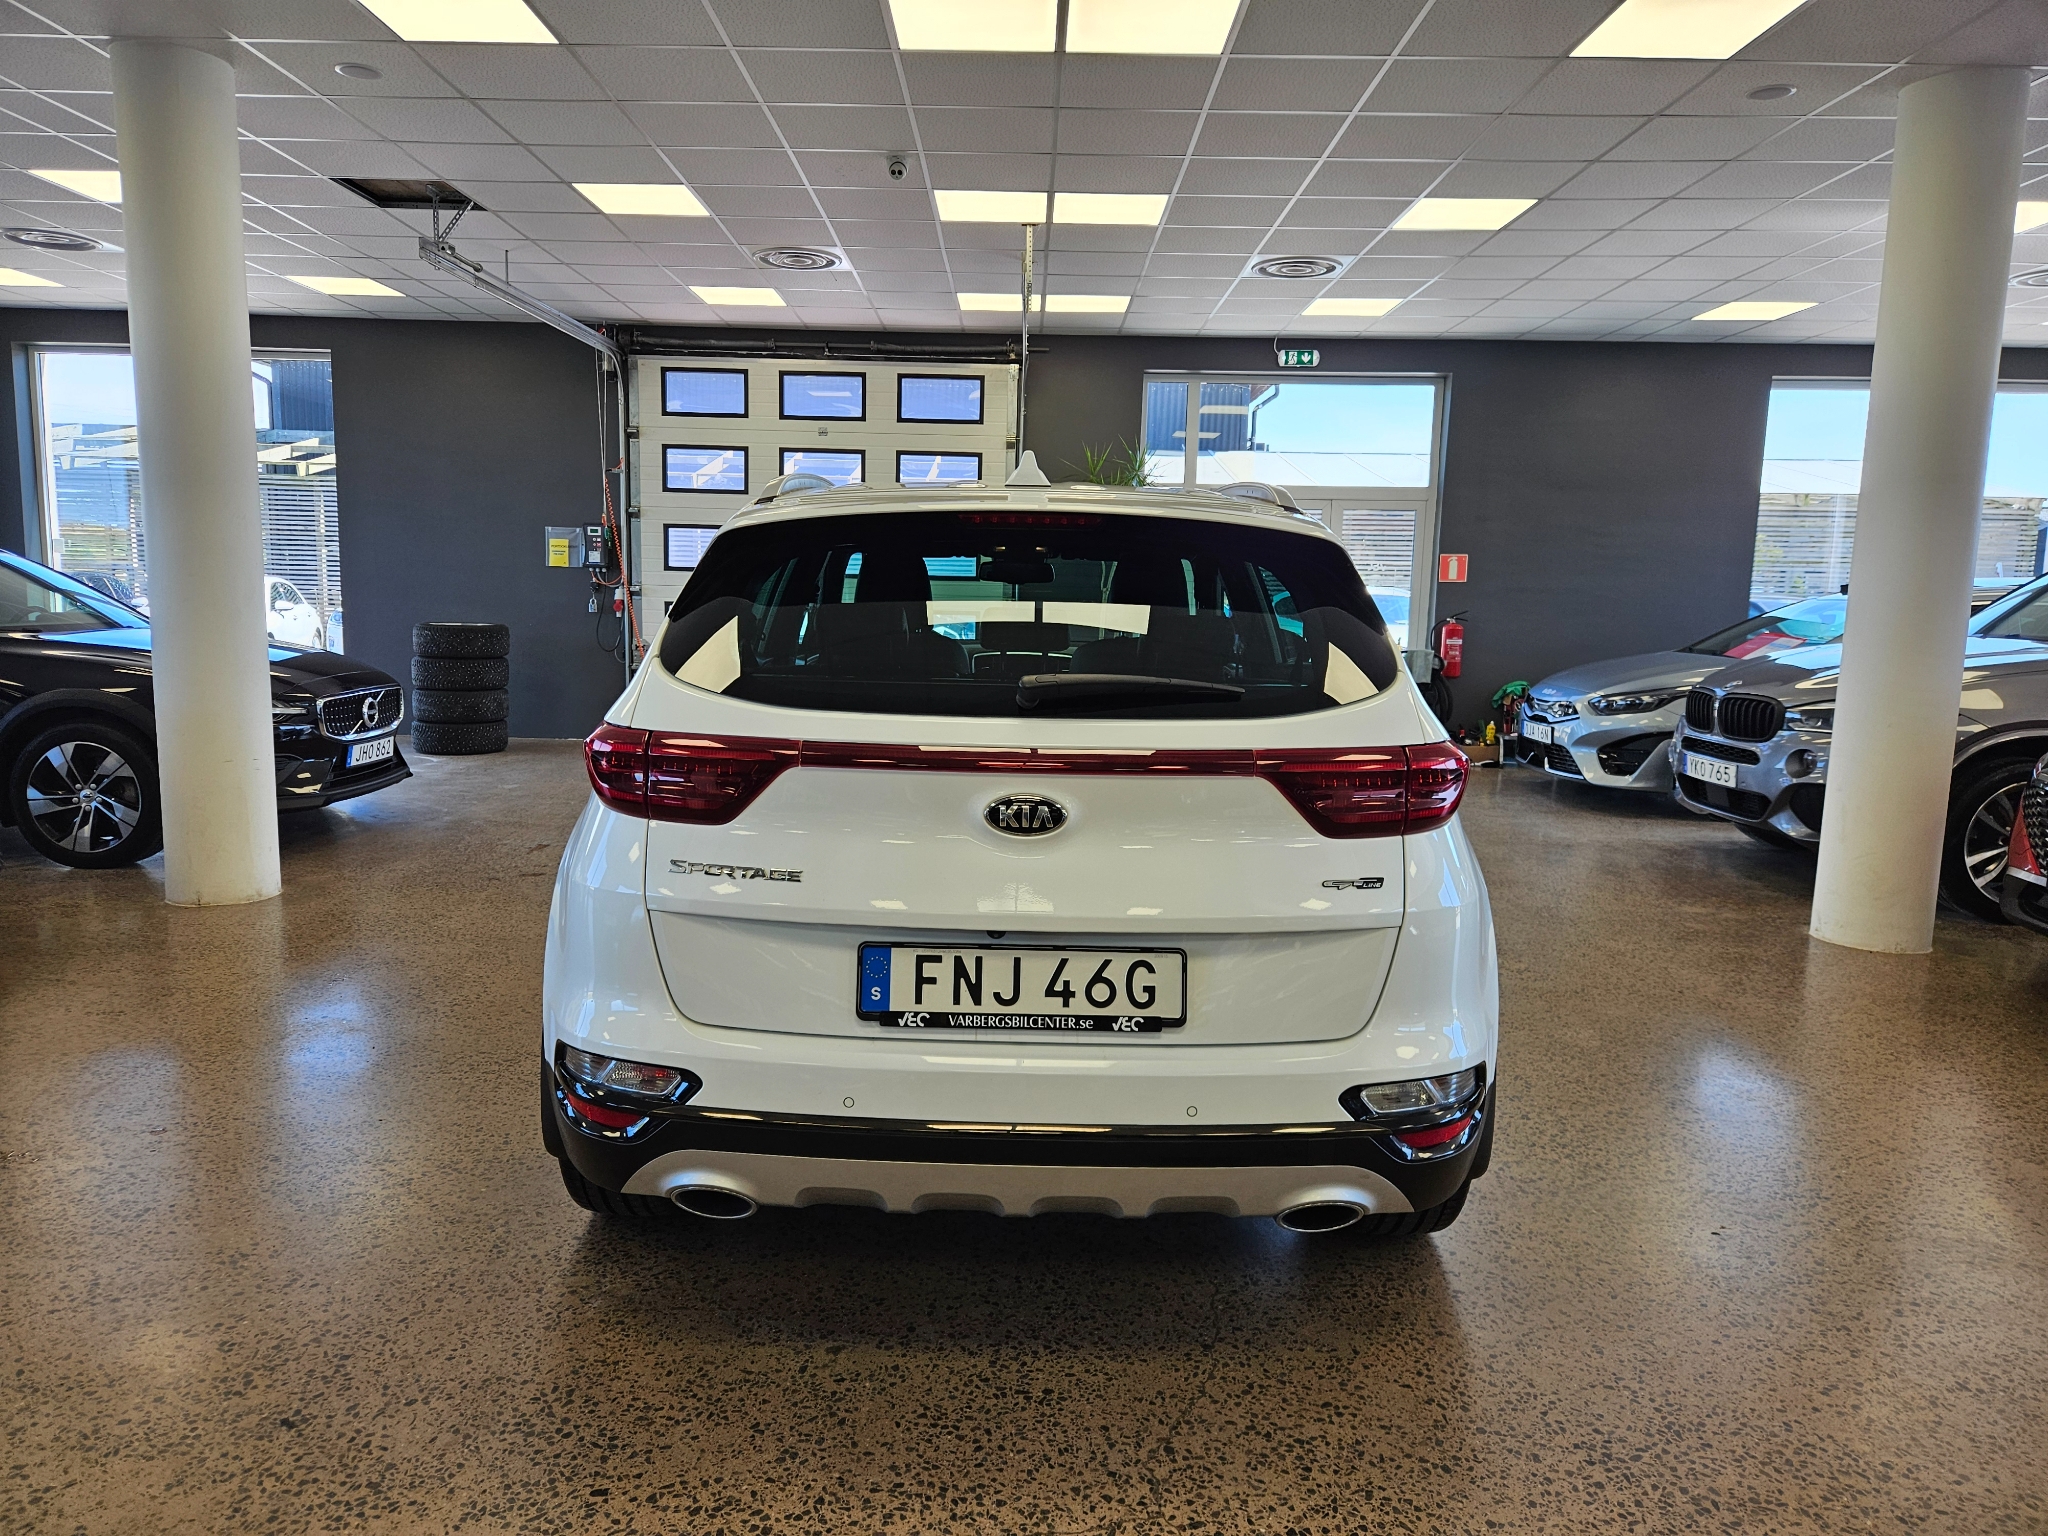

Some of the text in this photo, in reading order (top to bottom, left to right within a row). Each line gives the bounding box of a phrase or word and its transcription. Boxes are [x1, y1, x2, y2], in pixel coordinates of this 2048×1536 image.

[355, 739, 391, 762] JHO 862
[1708, 763, 1731, 783] 765
[999, 804, 1054, 828] KIA
[668, 859, 803, 883] SPORTAGE
[870, 986, 882, 1001] S
[914, 954, 1157, 1010] FNJ 46G
[948, 1013, 1094, 1030] VARBERGSBILCENTER.se
